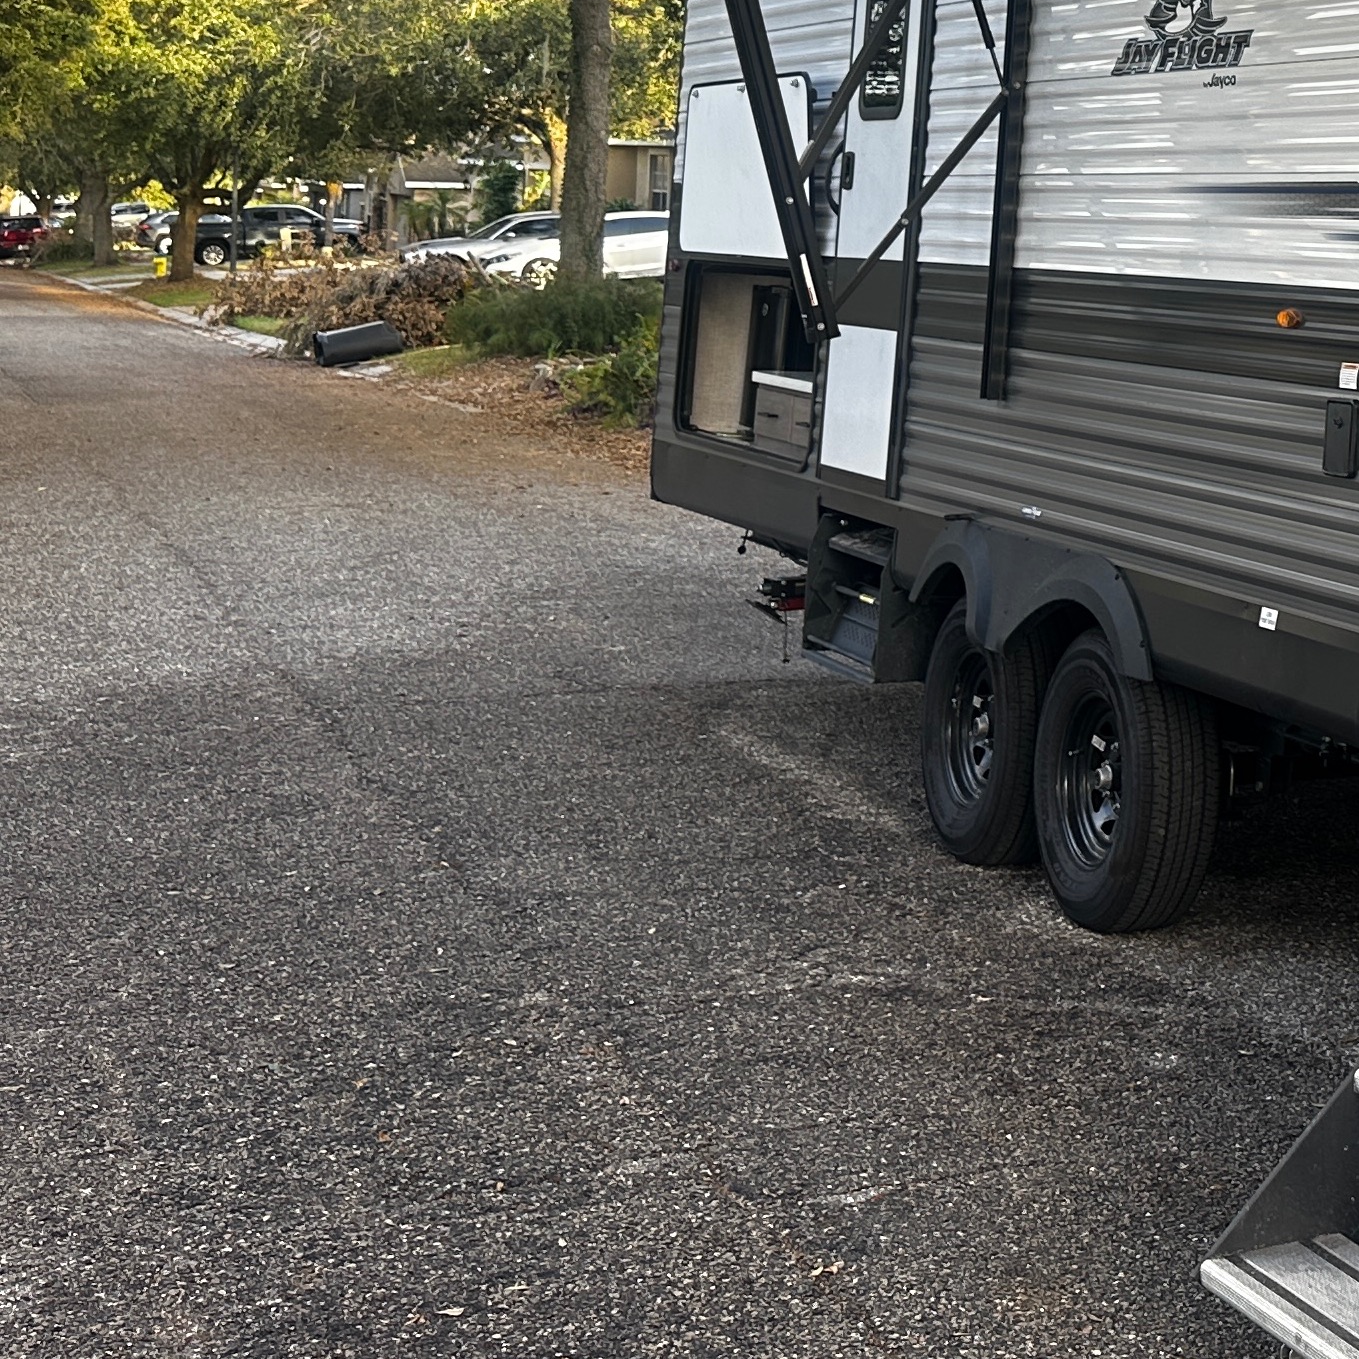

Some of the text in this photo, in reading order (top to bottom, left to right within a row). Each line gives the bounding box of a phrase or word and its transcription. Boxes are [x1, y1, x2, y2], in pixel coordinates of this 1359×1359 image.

[1111, 29, 1254, 76] JAY FLIGHT
[1208, 73, 1236, 89] Jayco
